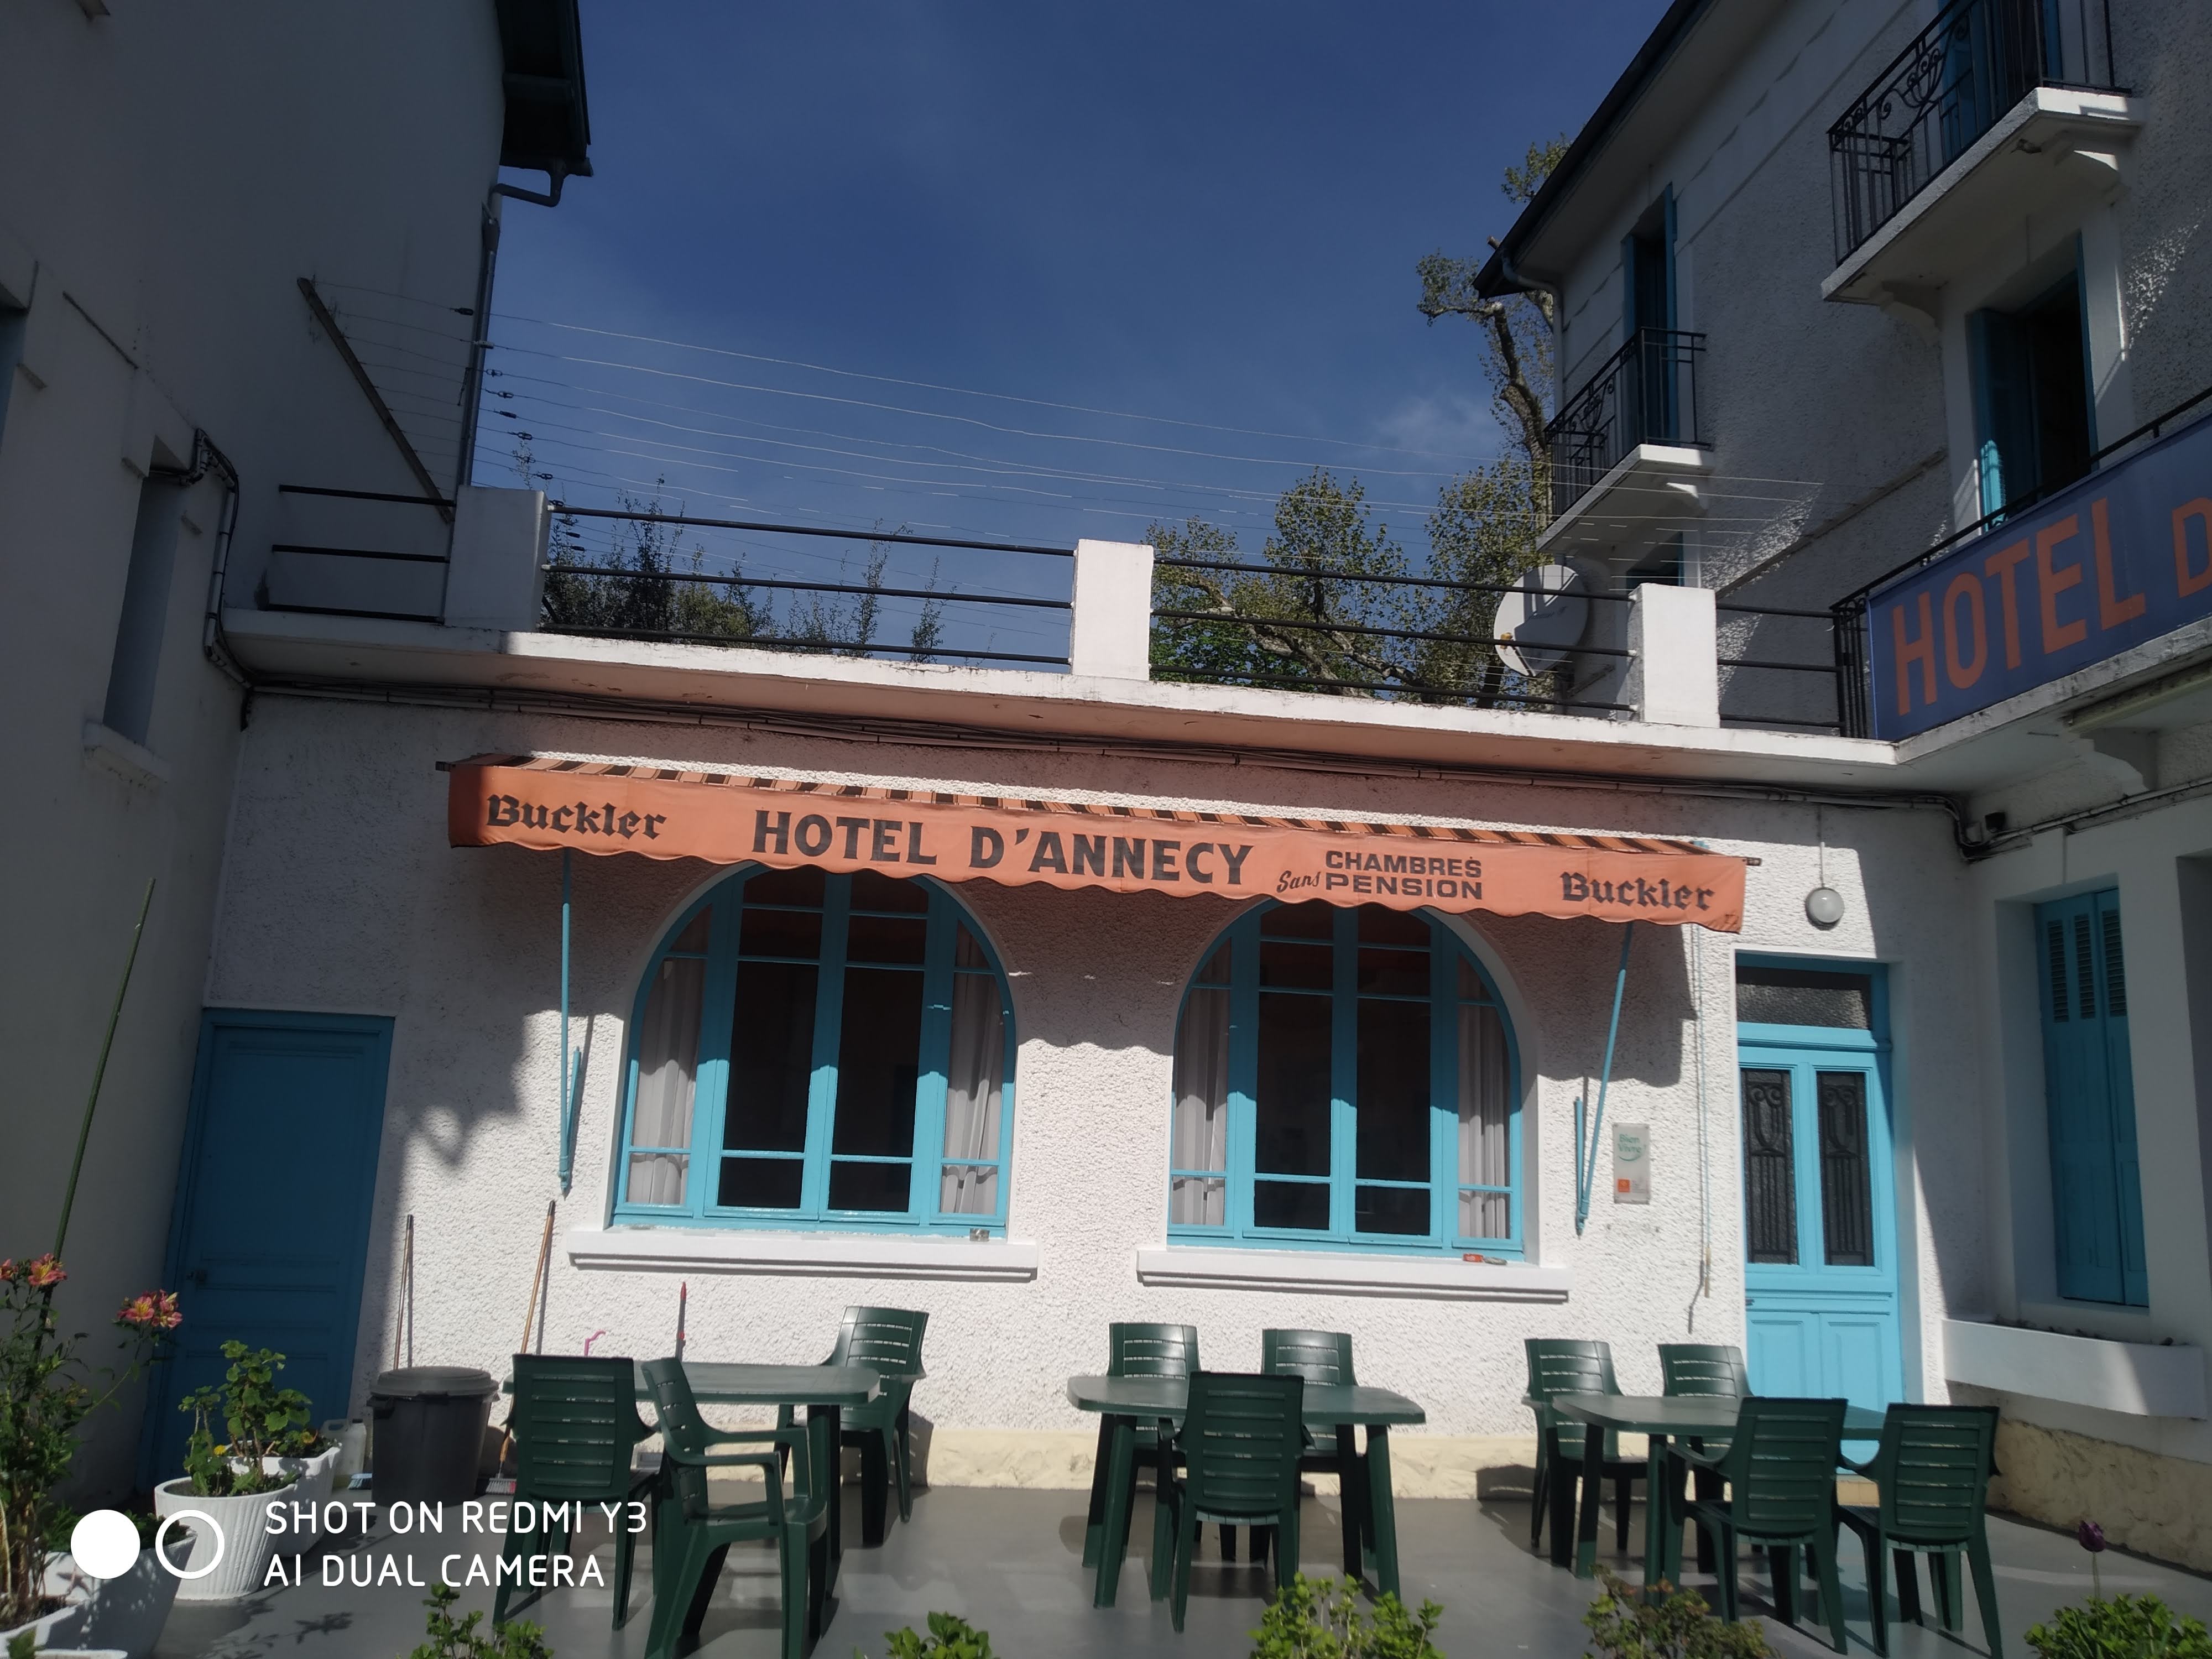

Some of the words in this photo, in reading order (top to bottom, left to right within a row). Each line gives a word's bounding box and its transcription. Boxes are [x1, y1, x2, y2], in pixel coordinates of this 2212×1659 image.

[1892, 498, 2146, 716] HOTEL
[487, 794, 667, 840] Buckler
[752, 810, 937, 865] HOTEL
[969, 825, 1254, 885] D'ANNECY
[1324, 850, 1482, 878] CHAMBRES
[1276, 870, 1321, 894] Sans
[1326, 873, 1482, 900] PENSION
[1560, 872, 1714, 911] Buckler
